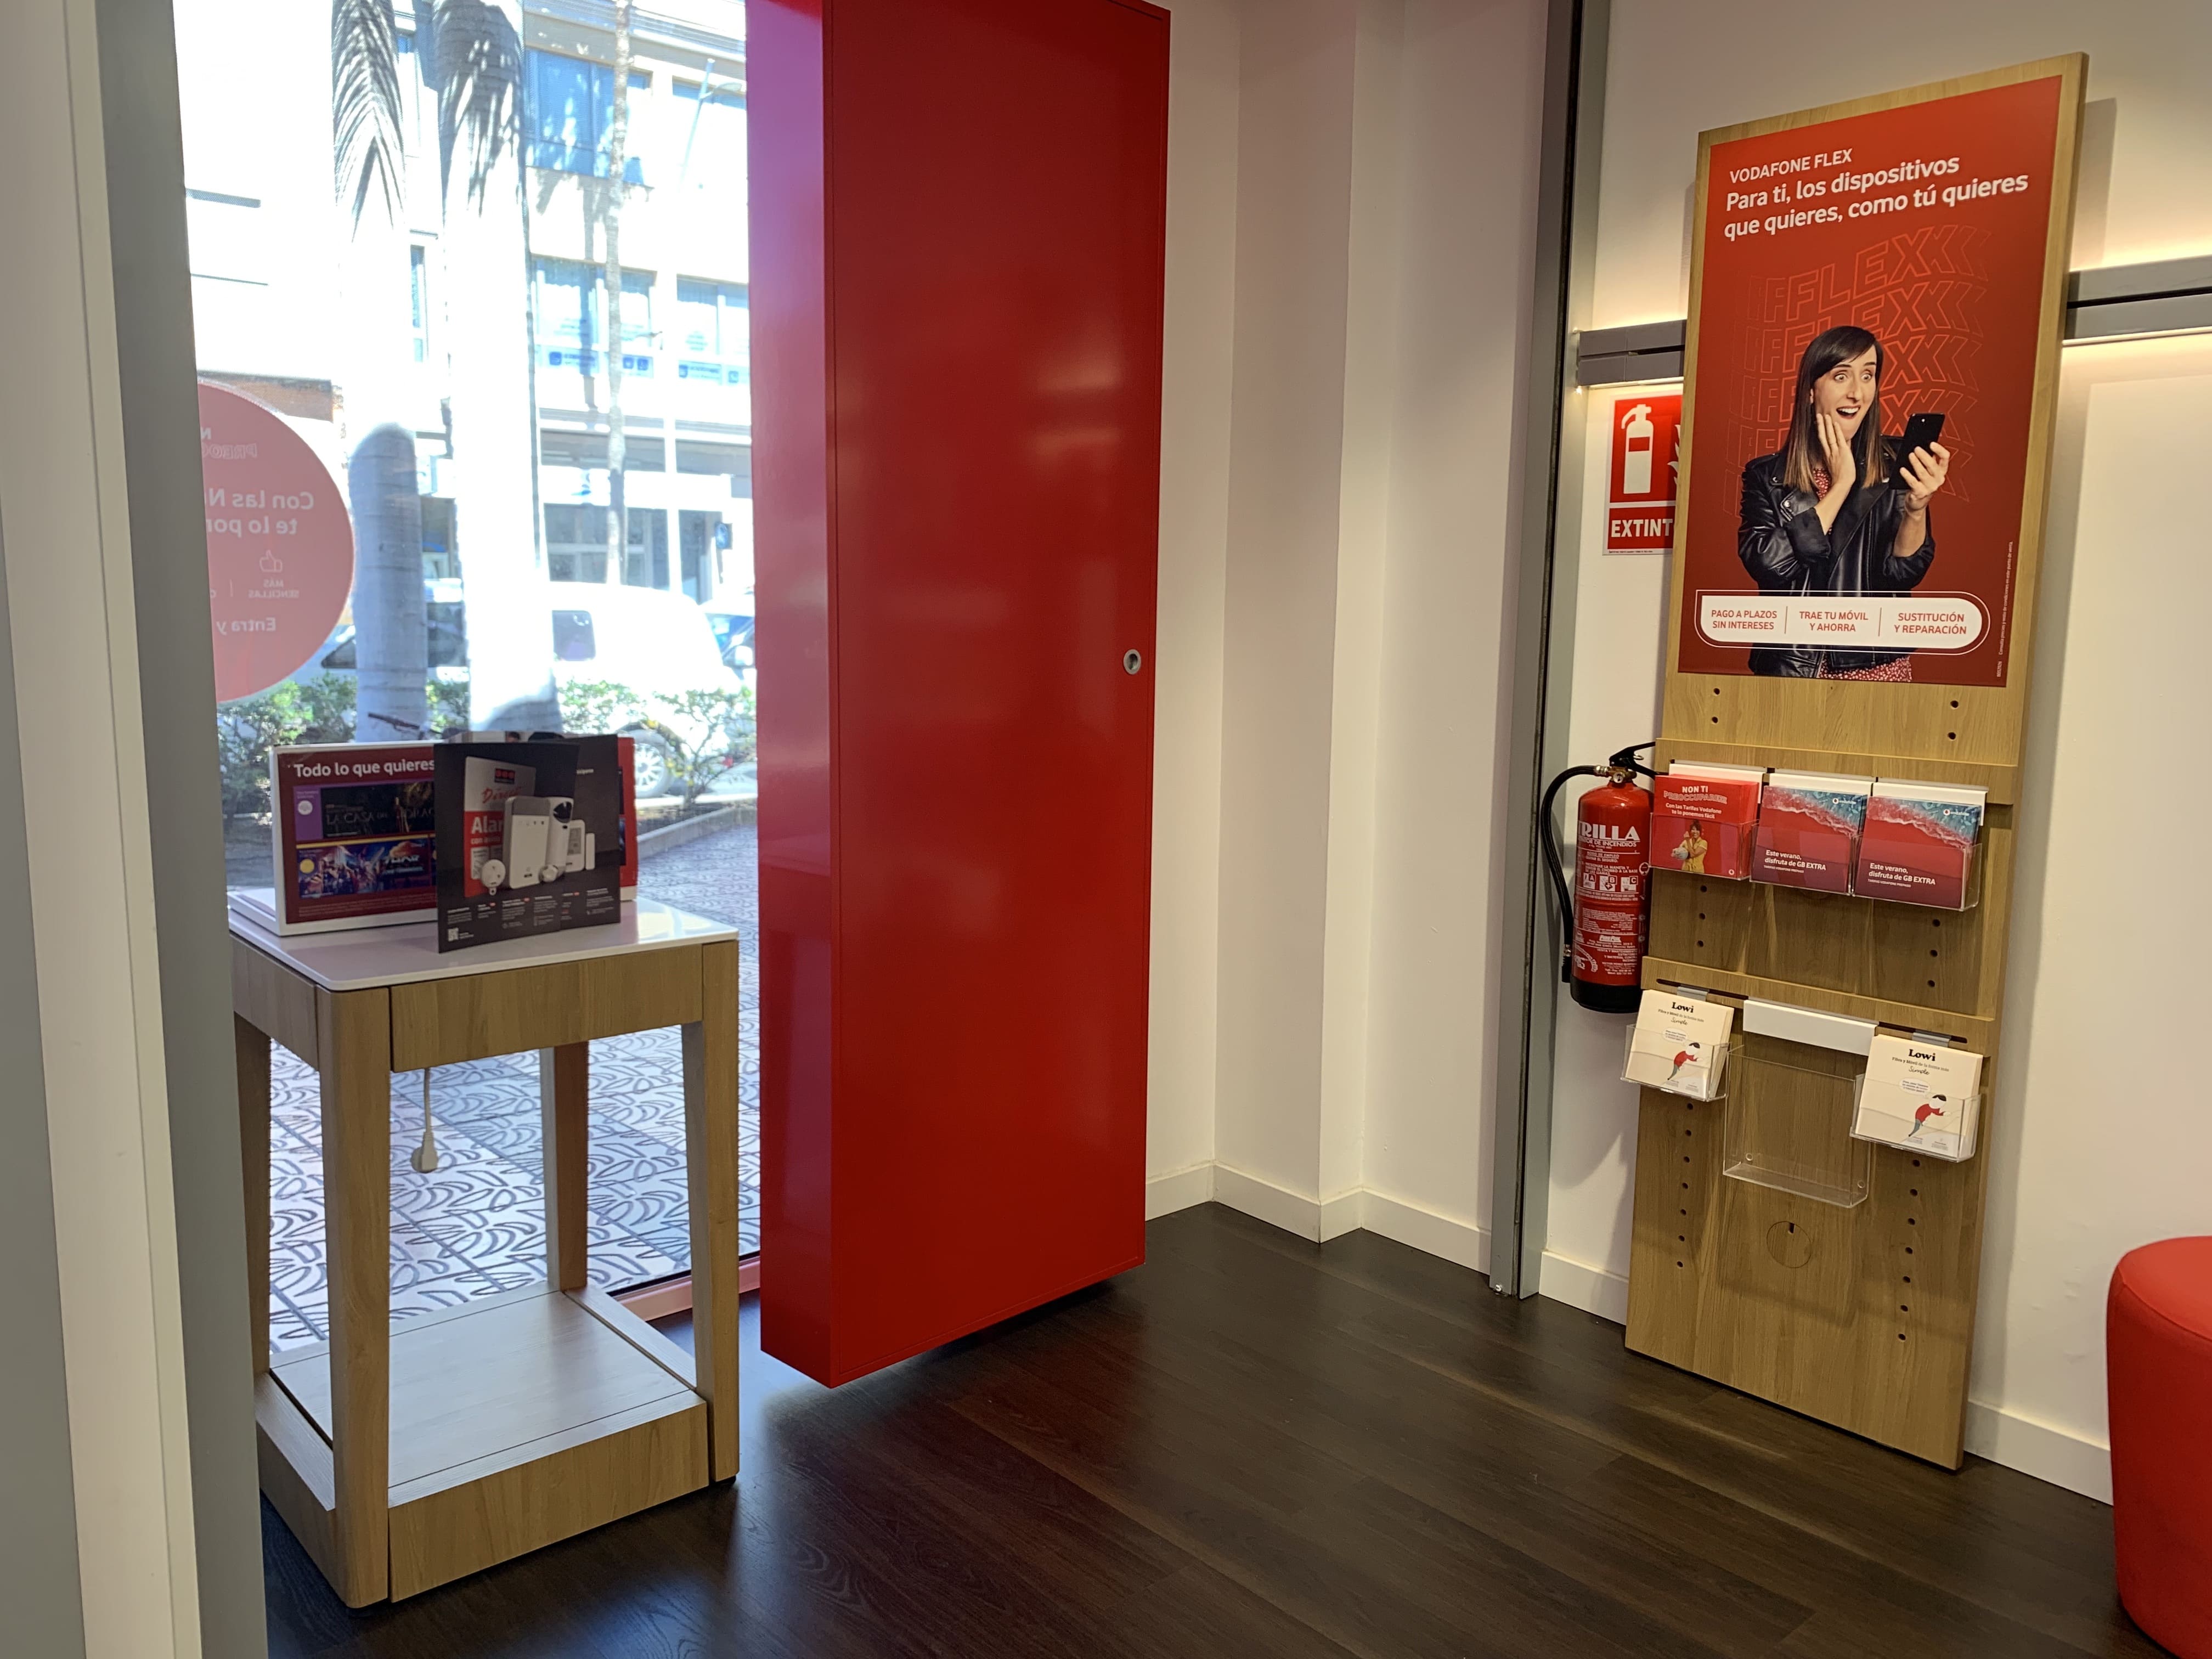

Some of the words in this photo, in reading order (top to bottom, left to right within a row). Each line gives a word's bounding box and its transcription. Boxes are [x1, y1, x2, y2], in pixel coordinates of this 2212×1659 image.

[1729, 157, 1811, 184] VODAFONE
[1814, 148, 1853, 170] FLEX
[1725, 189, 1767, 212] Para
[1772, 185, 1791, 205] ti,
[1796, 178, 1826, 201] los
[1831, 156, 1960, 194] dispositivos
[1724, 220, 1759, 242] que
[1764, 206, 1843, 236] quieres,
[1847, 194, 1909, 218] como
[1913, 184, 1937, 208] tú
[1942, 174, 2029, 208] quieres
[1711, 610, 1735, 618] PAGO
[1737, 610, 1742, 618] A
[1744, 610, 1778, 619] PLAZOS
[1799, 611, 1822, 620] TRAE
[1825, 612, 1836, 620] TU
[1839, 610, 1869, 621] MÓVIL
[1898, 611, 1965, 623] SUSTITUCIÓN
[1728, 622, 1775, 630] INTERESES
[1817, 623, 1856, 632] AHORRA
[1894, 625, 1900, 633] Y
[1903, 623, 1967, 635] REPARACIÓN
[294, 763, 331, 777] Todo
[334, 762, 349, 775] lo
[353, 764, 380, 777] que
[383, 759, 435, 776] quieres
[1780, 852, 1802, 860] verano,
[1764, 857, 1788, 865] disfruta
[1806, 862, 1826, 871] EXTRA
[1885, 866, 1908, 874] verano,
[1869, 871, 1893, 879] disfruta
[1913, 876, 1936, 885] EXTRA
[1672, 1002, 1694, 1013] Lowi
[1908, 1048, 1936, 1062] Lowi
[1909, 1065, 1930, 1075] Simple
